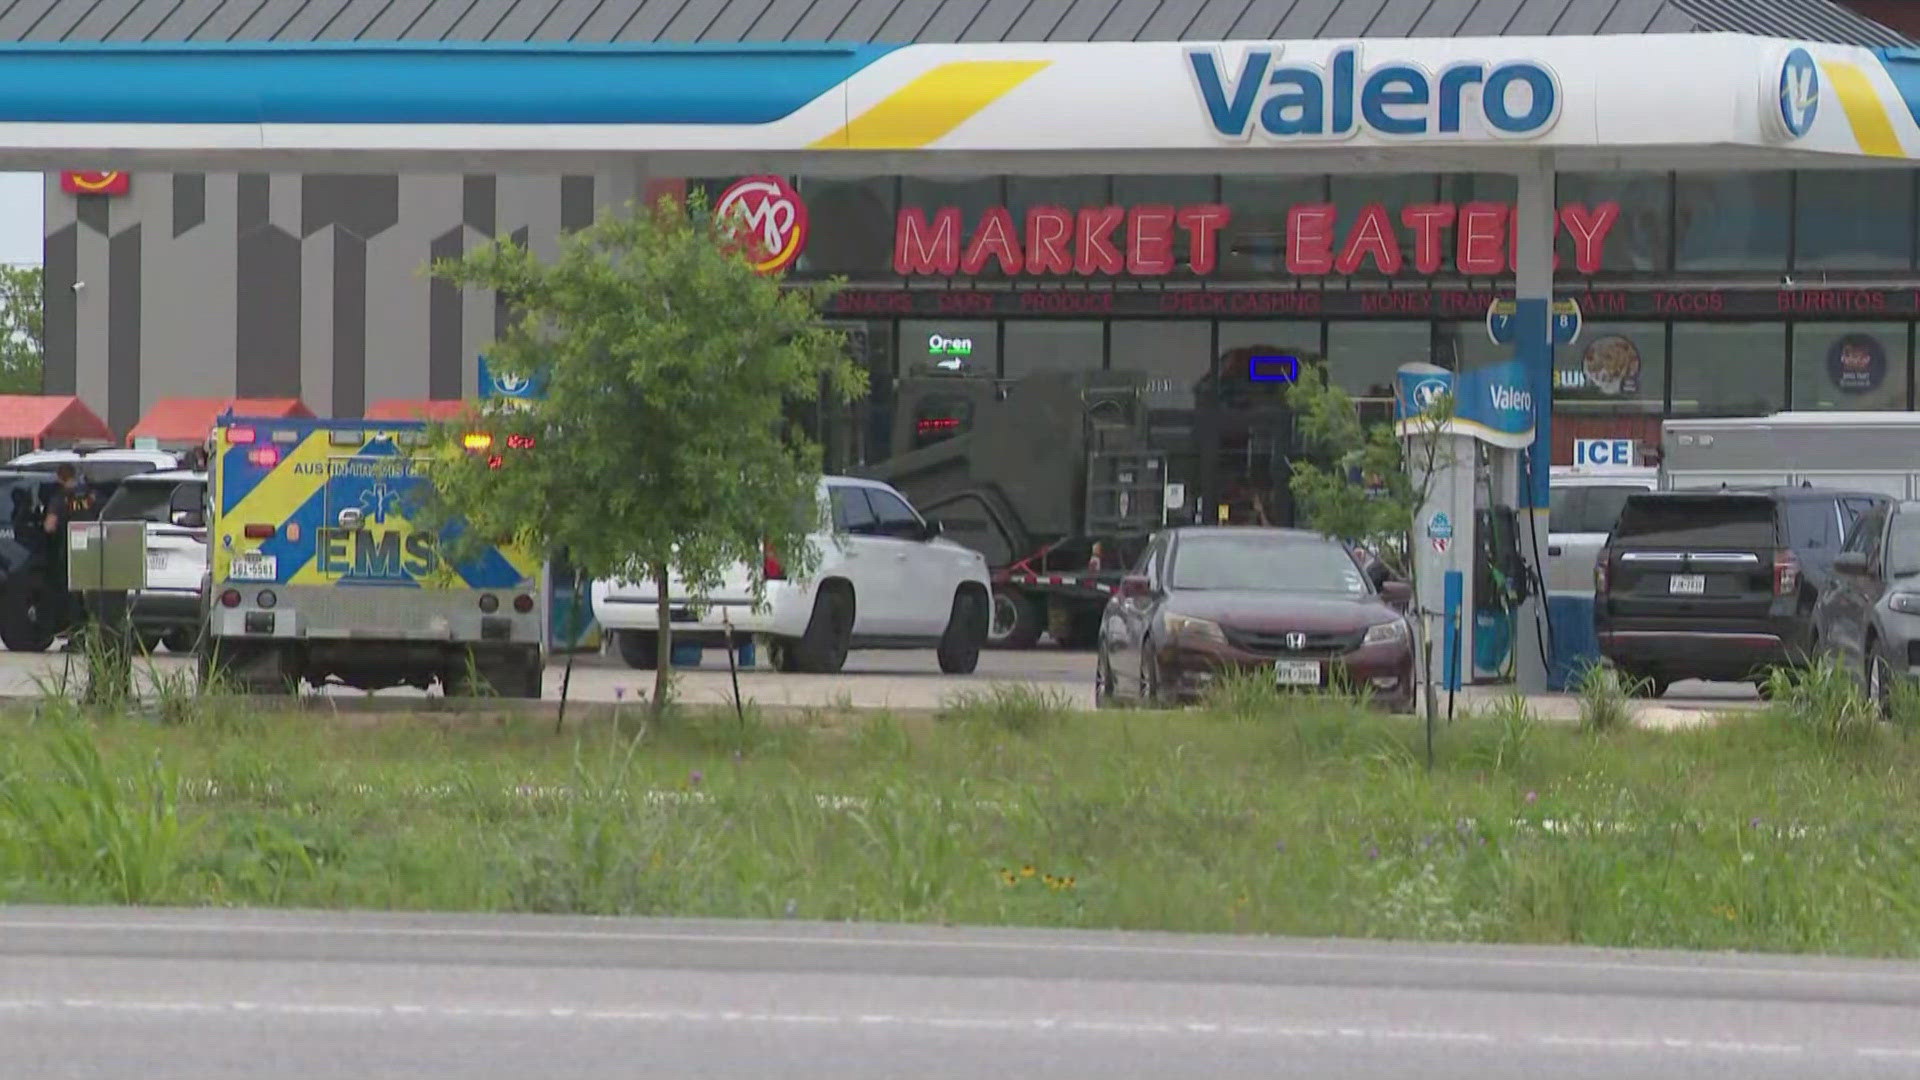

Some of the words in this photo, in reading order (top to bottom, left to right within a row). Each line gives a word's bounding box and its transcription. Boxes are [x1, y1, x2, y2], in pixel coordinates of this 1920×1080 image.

[1190, 50, 1555, 136] Valero
[895, 206, 1230, 275] MARKET
[1286, 203, 1621, 275] EATEY
[1021, 291, 1112, 312] PRODUCE
[1160, 292, 1227, 312] CHECK
[1231, 292, 1322, 313] CASHING
[1361, 290, 1432, 312] MONEY
[1584, 292, 1626, 312] ATM
[1653, 293, 1724, 312] TACOS
[1777, 291, 1886, 313] BURRITOS
[1500, 315, 1508, 329] 7
[1559, 315, 1568, 329] 8
[1490, 384, 1531, 411] Valero
[1577, 440, 1629, 465] ICE
[316, 528, 432, 577] EMS
